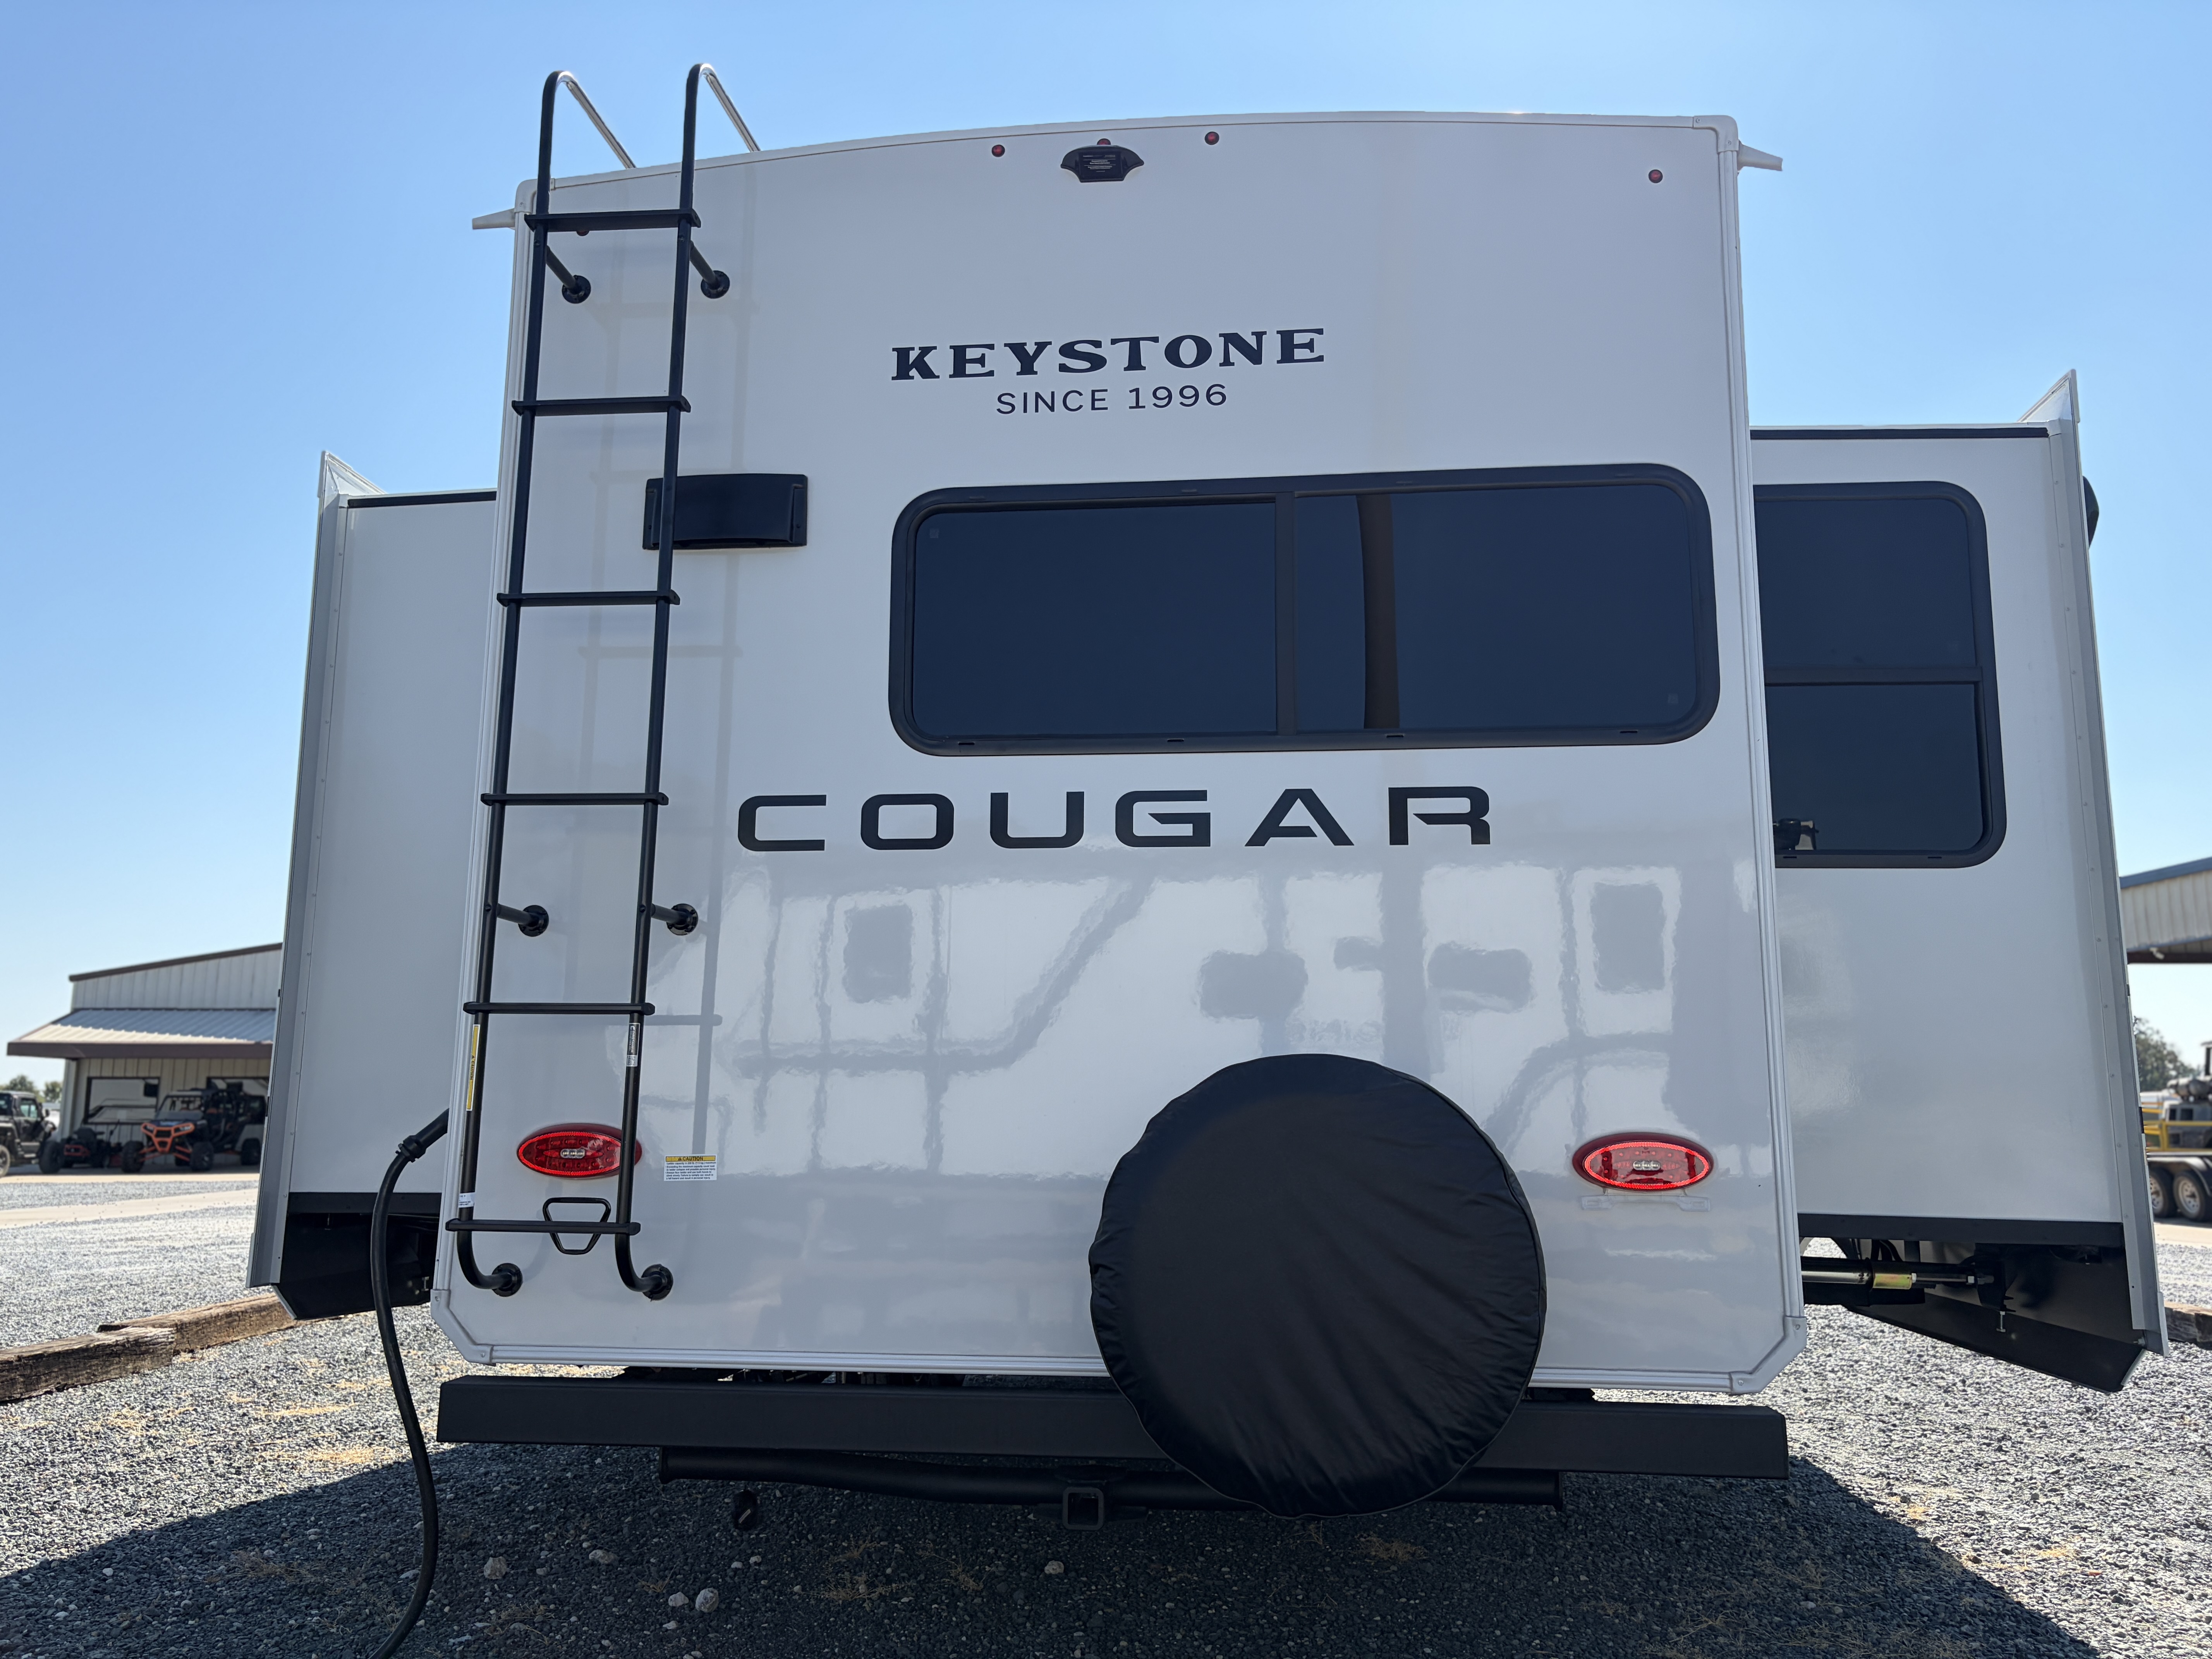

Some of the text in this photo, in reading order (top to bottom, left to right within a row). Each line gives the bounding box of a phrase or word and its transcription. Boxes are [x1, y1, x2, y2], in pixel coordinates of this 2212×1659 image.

[891, 328, 1324, 381] KEYSTONE
[996, 384, 1226, 414] SINCE 1996
[737, 786, 1491, 852] COUGAR
